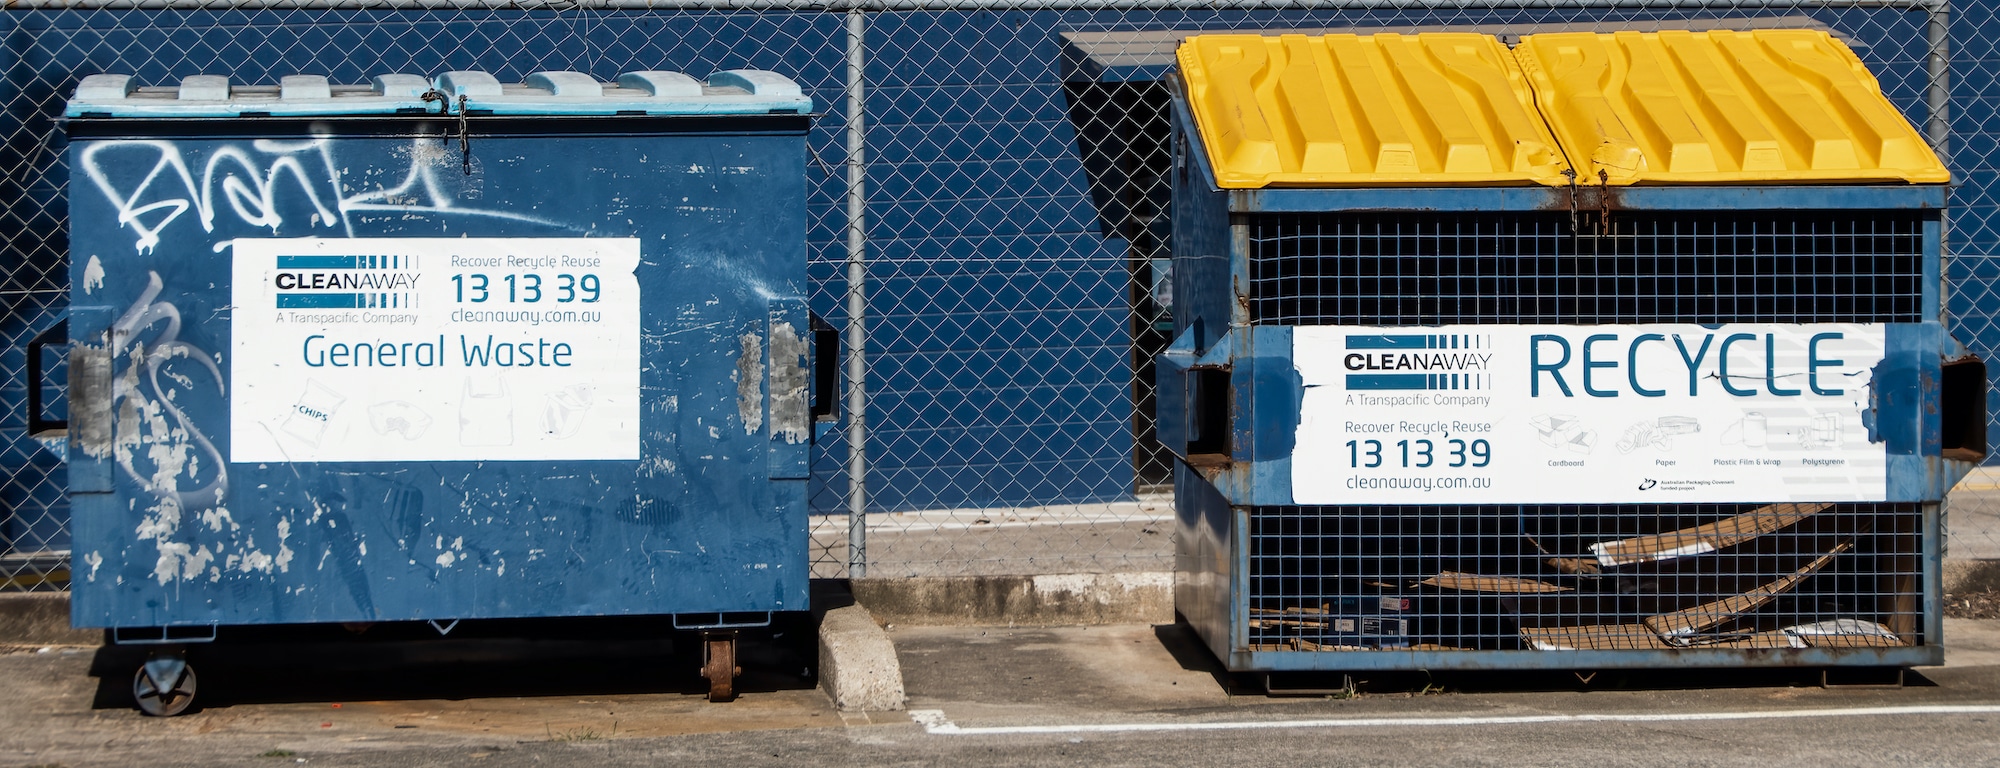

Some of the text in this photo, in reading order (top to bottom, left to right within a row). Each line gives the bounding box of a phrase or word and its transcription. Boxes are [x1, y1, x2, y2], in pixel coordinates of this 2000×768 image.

[451, 254, 601, 270] Recover Recycle Reuse
[275, 273, 421, 290] CLEANAWAY
[451, 273, 601, 303] 13 13 39
[275, 312, 419, 325] A Transpacific Company
[451, 308, 601, 326] cleanaway.com.au
[303, 334, 573, 367] General Waste
[1344, 353, 1492, 370] CLEANAWAY
[1530, 332, 1844, 397] RECYCLE
[1346, 394, 1491, 407] A Transpacific Company
[299, 405, 329, 422] CHIPS
[1346, 421, 1491, 435] Recover Recycle Reuse
[1346, 439, 1491, 468] 13 13 39
[1802, 457, 1845, 467] Polystyrene
[1548, 459, 1585, 467] Cardboard
[1655, 459, 1676, 467] Paper
[1713, 458, 1737, 466] Plastic
[1739, 458, 1755, 466] Film
[1763, 459, 1782, 467] Wrap
[1346, 474, 1491, 492] cleanaway.com.au
